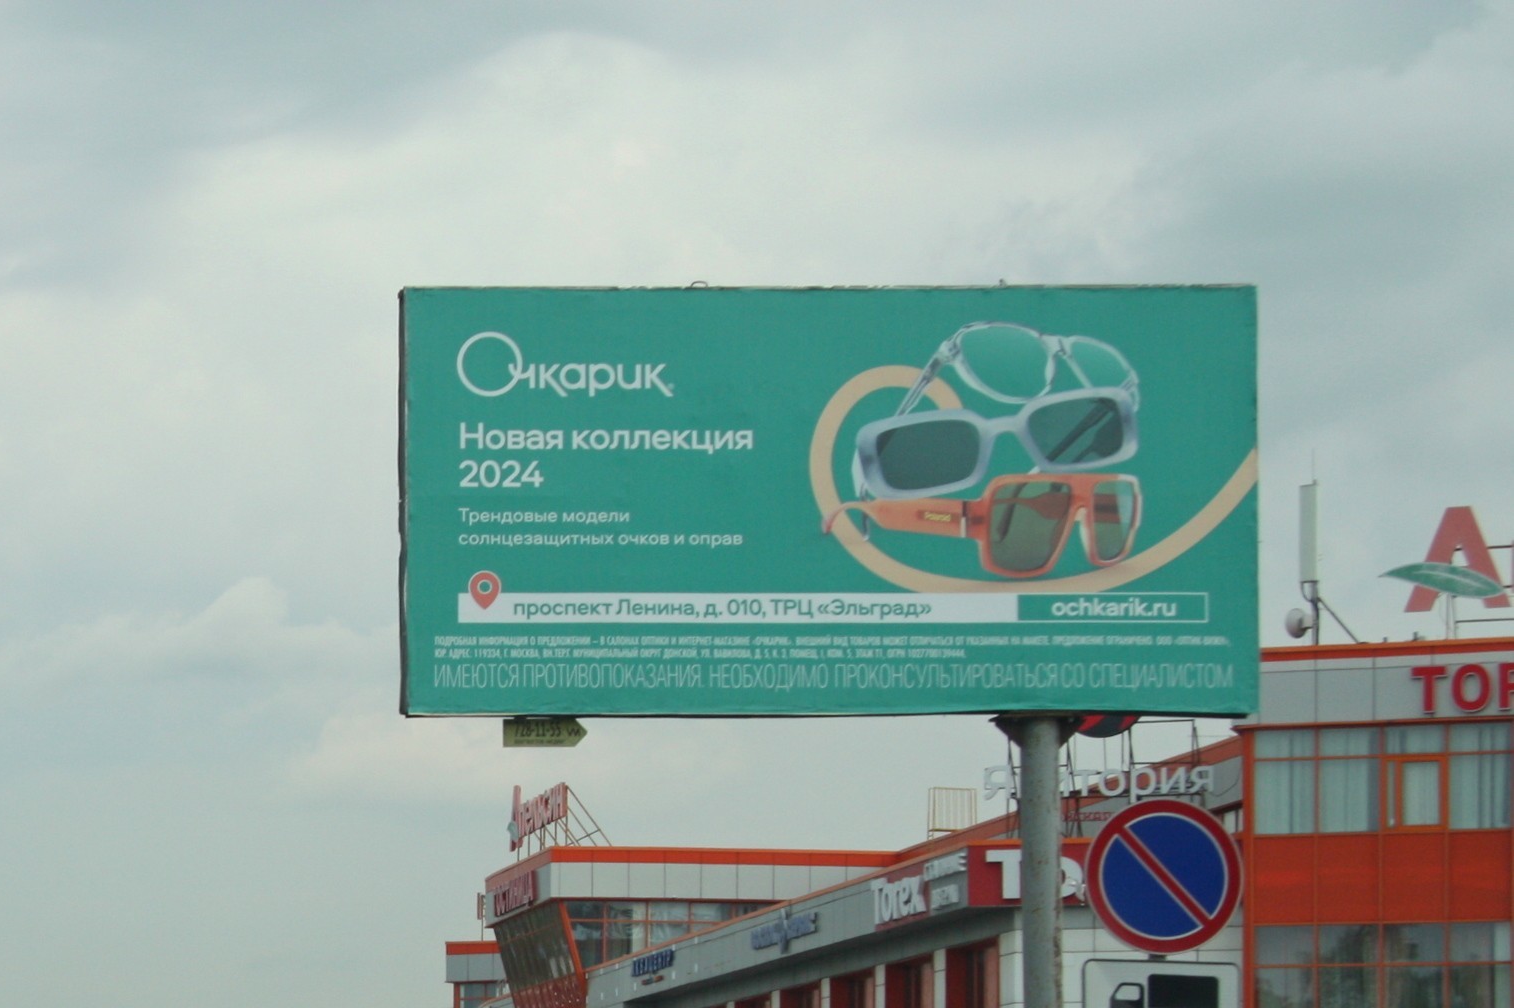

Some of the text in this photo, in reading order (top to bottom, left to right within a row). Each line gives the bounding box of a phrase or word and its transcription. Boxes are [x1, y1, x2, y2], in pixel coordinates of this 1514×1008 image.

[457, 331, 674, 397] Очкарик
[459, 422, 754, 455] Новая коллекция
[458, 459, 544, 488] 2024
[457, 507, 631, 526] Трендовые модели
[457, 532, 744, 548] солнцезащитных очков и оправ
[1403, 505, 1514, 613] А
[512, 599, 932, 619] проспект Ленина, д. 010, ТРЦ «Эльград»
[1050, 597, 1177, 617] ochkarik.ru
[435, 662, 1234, 691] ИМЕЮТСЯ ПРОТИВОПОКАЗАНИЯ. НЕОБХОДИМО ПРОКОНСУЛЬТИРОВАТЬСЯ СО СПЕЦИАЛИСТОМ
[984, 764, 1215, 805] Ятория
